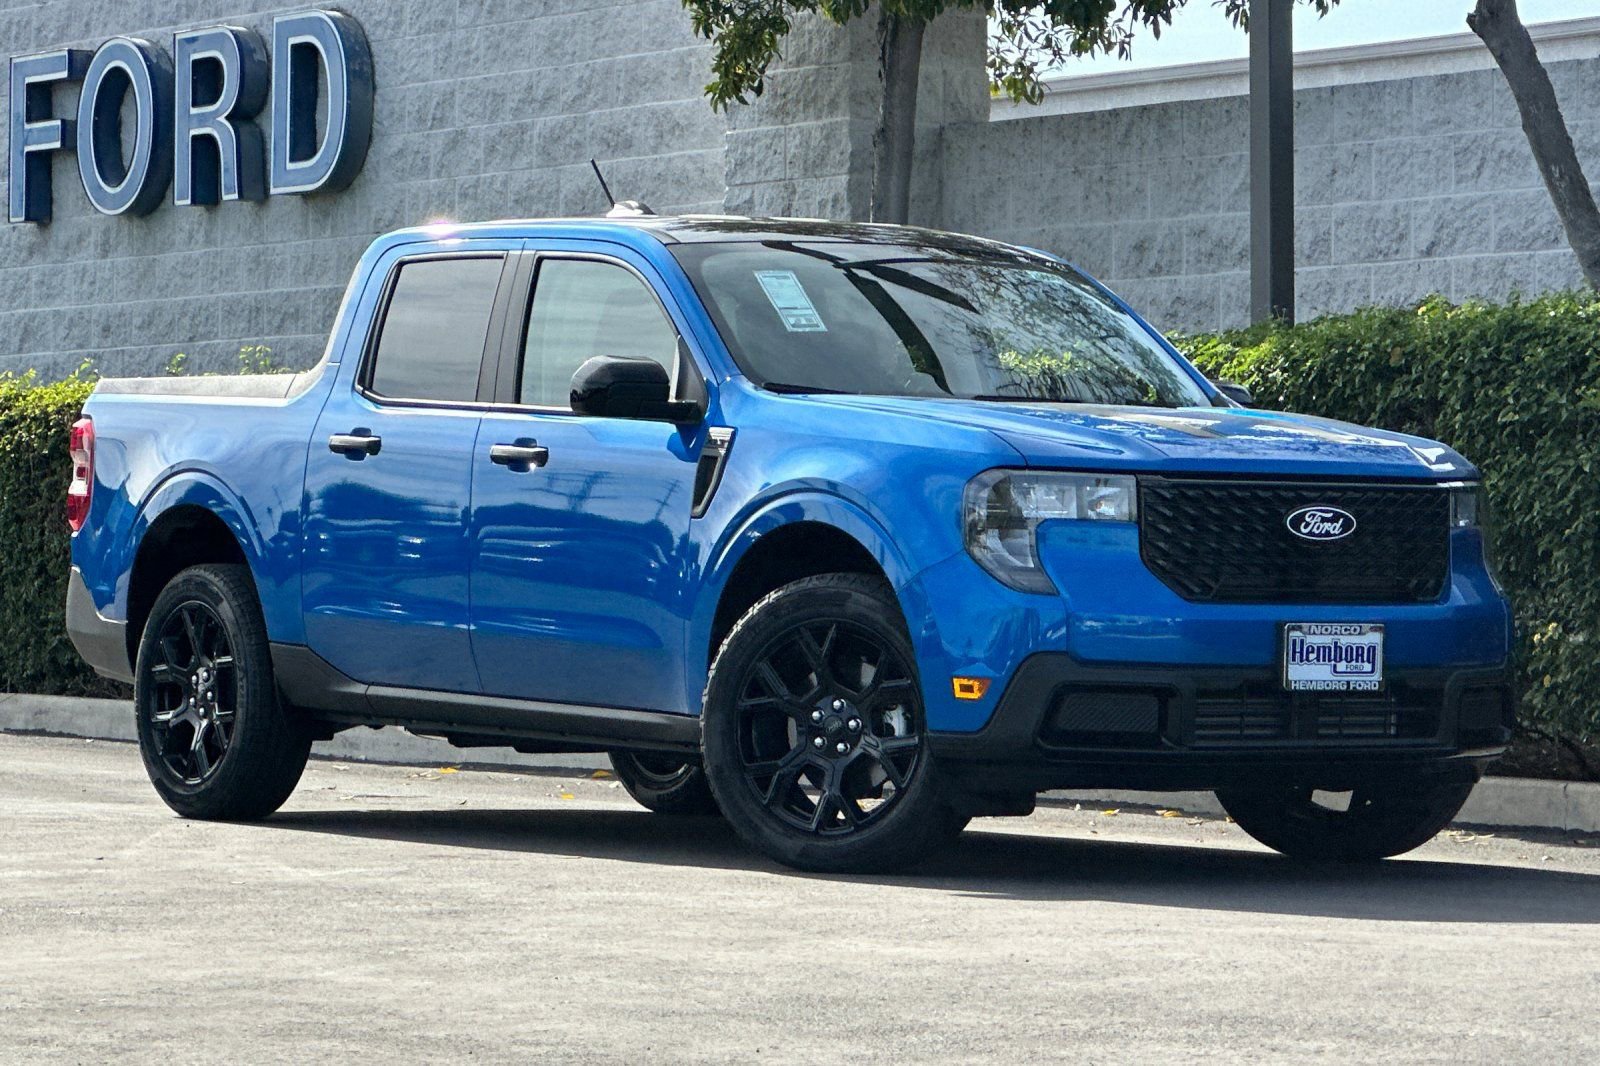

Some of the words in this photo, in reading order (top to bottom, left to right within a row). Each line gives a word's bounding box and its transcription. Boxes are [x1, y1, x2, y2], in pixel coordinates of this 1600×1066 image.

[8, 9, 358, 223] FORD
[1300, 511, 1344, 535] Ford
[1309, 625, 1361, 635] NORCO
[1291, 681, 1347, 691] HEMBORG
[1349, 681, 1379, 691] FORD
